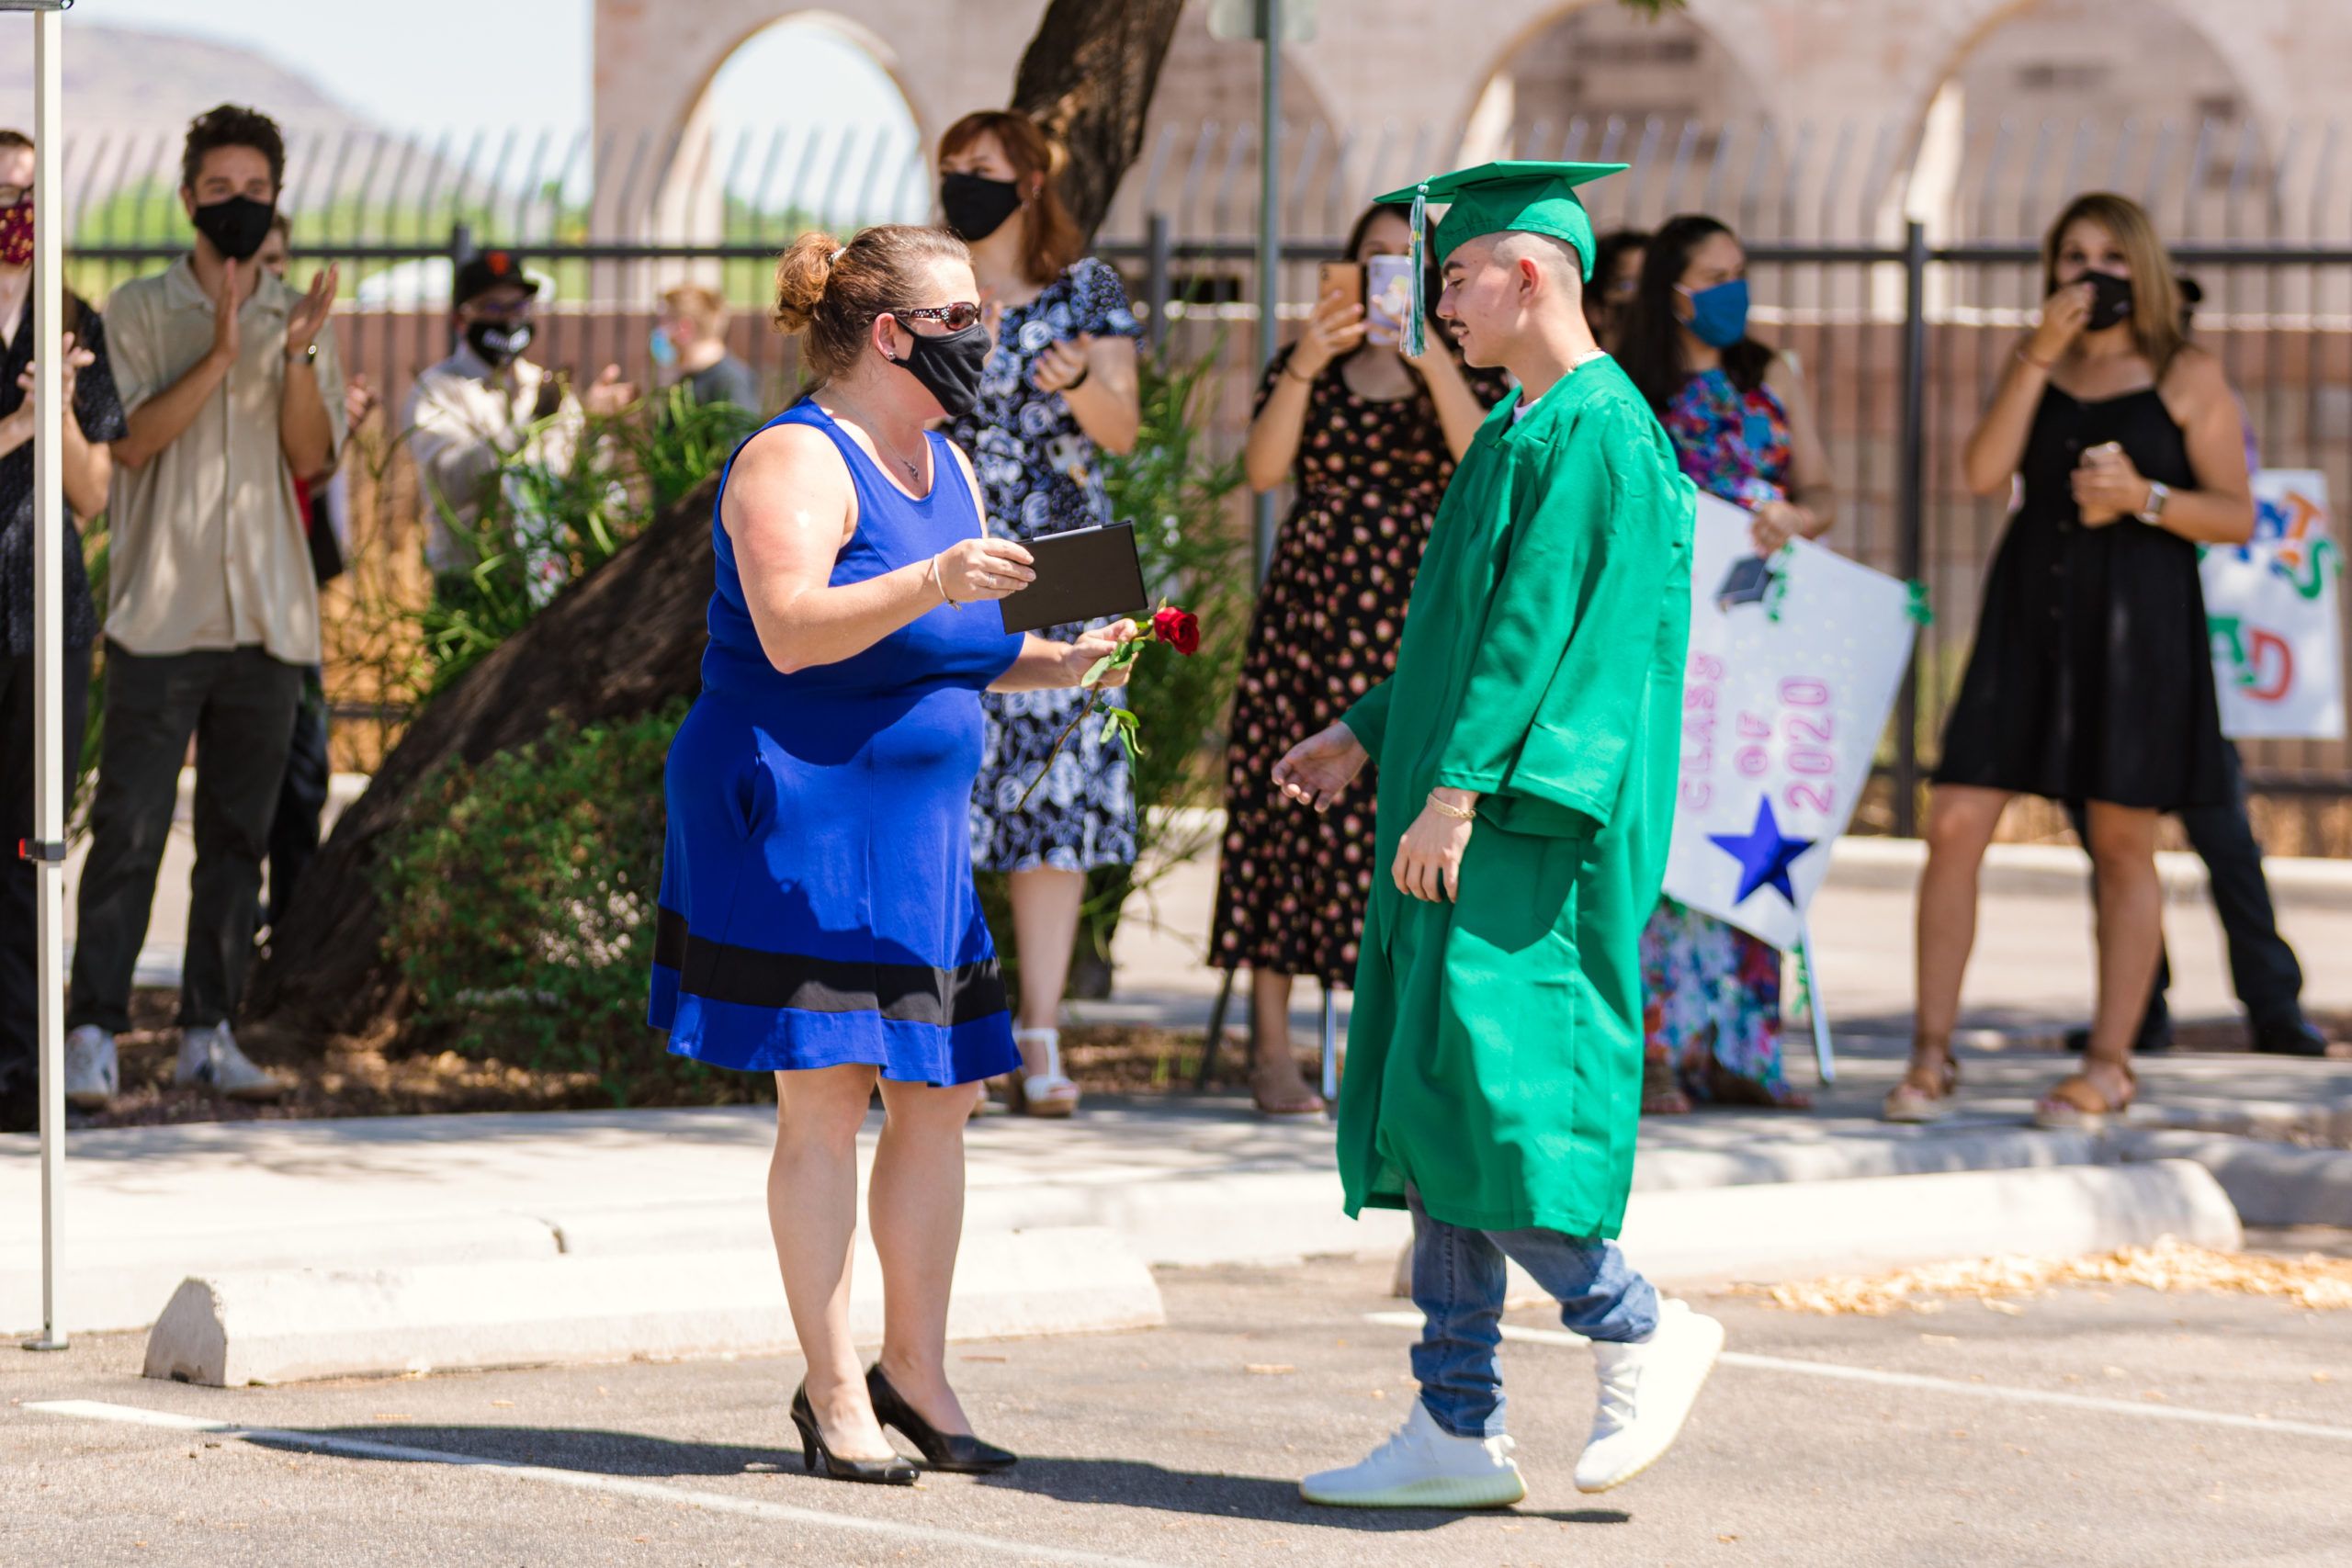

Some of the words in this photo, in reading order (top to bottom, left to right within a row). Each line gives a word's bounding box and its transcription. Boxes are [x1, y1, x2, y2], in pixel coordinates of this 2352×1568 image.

[1680, 653, 1723, 811] CLASS
[1736, 712, 1772, 777] OF
[1781, 677, 1835, 813] 2020
